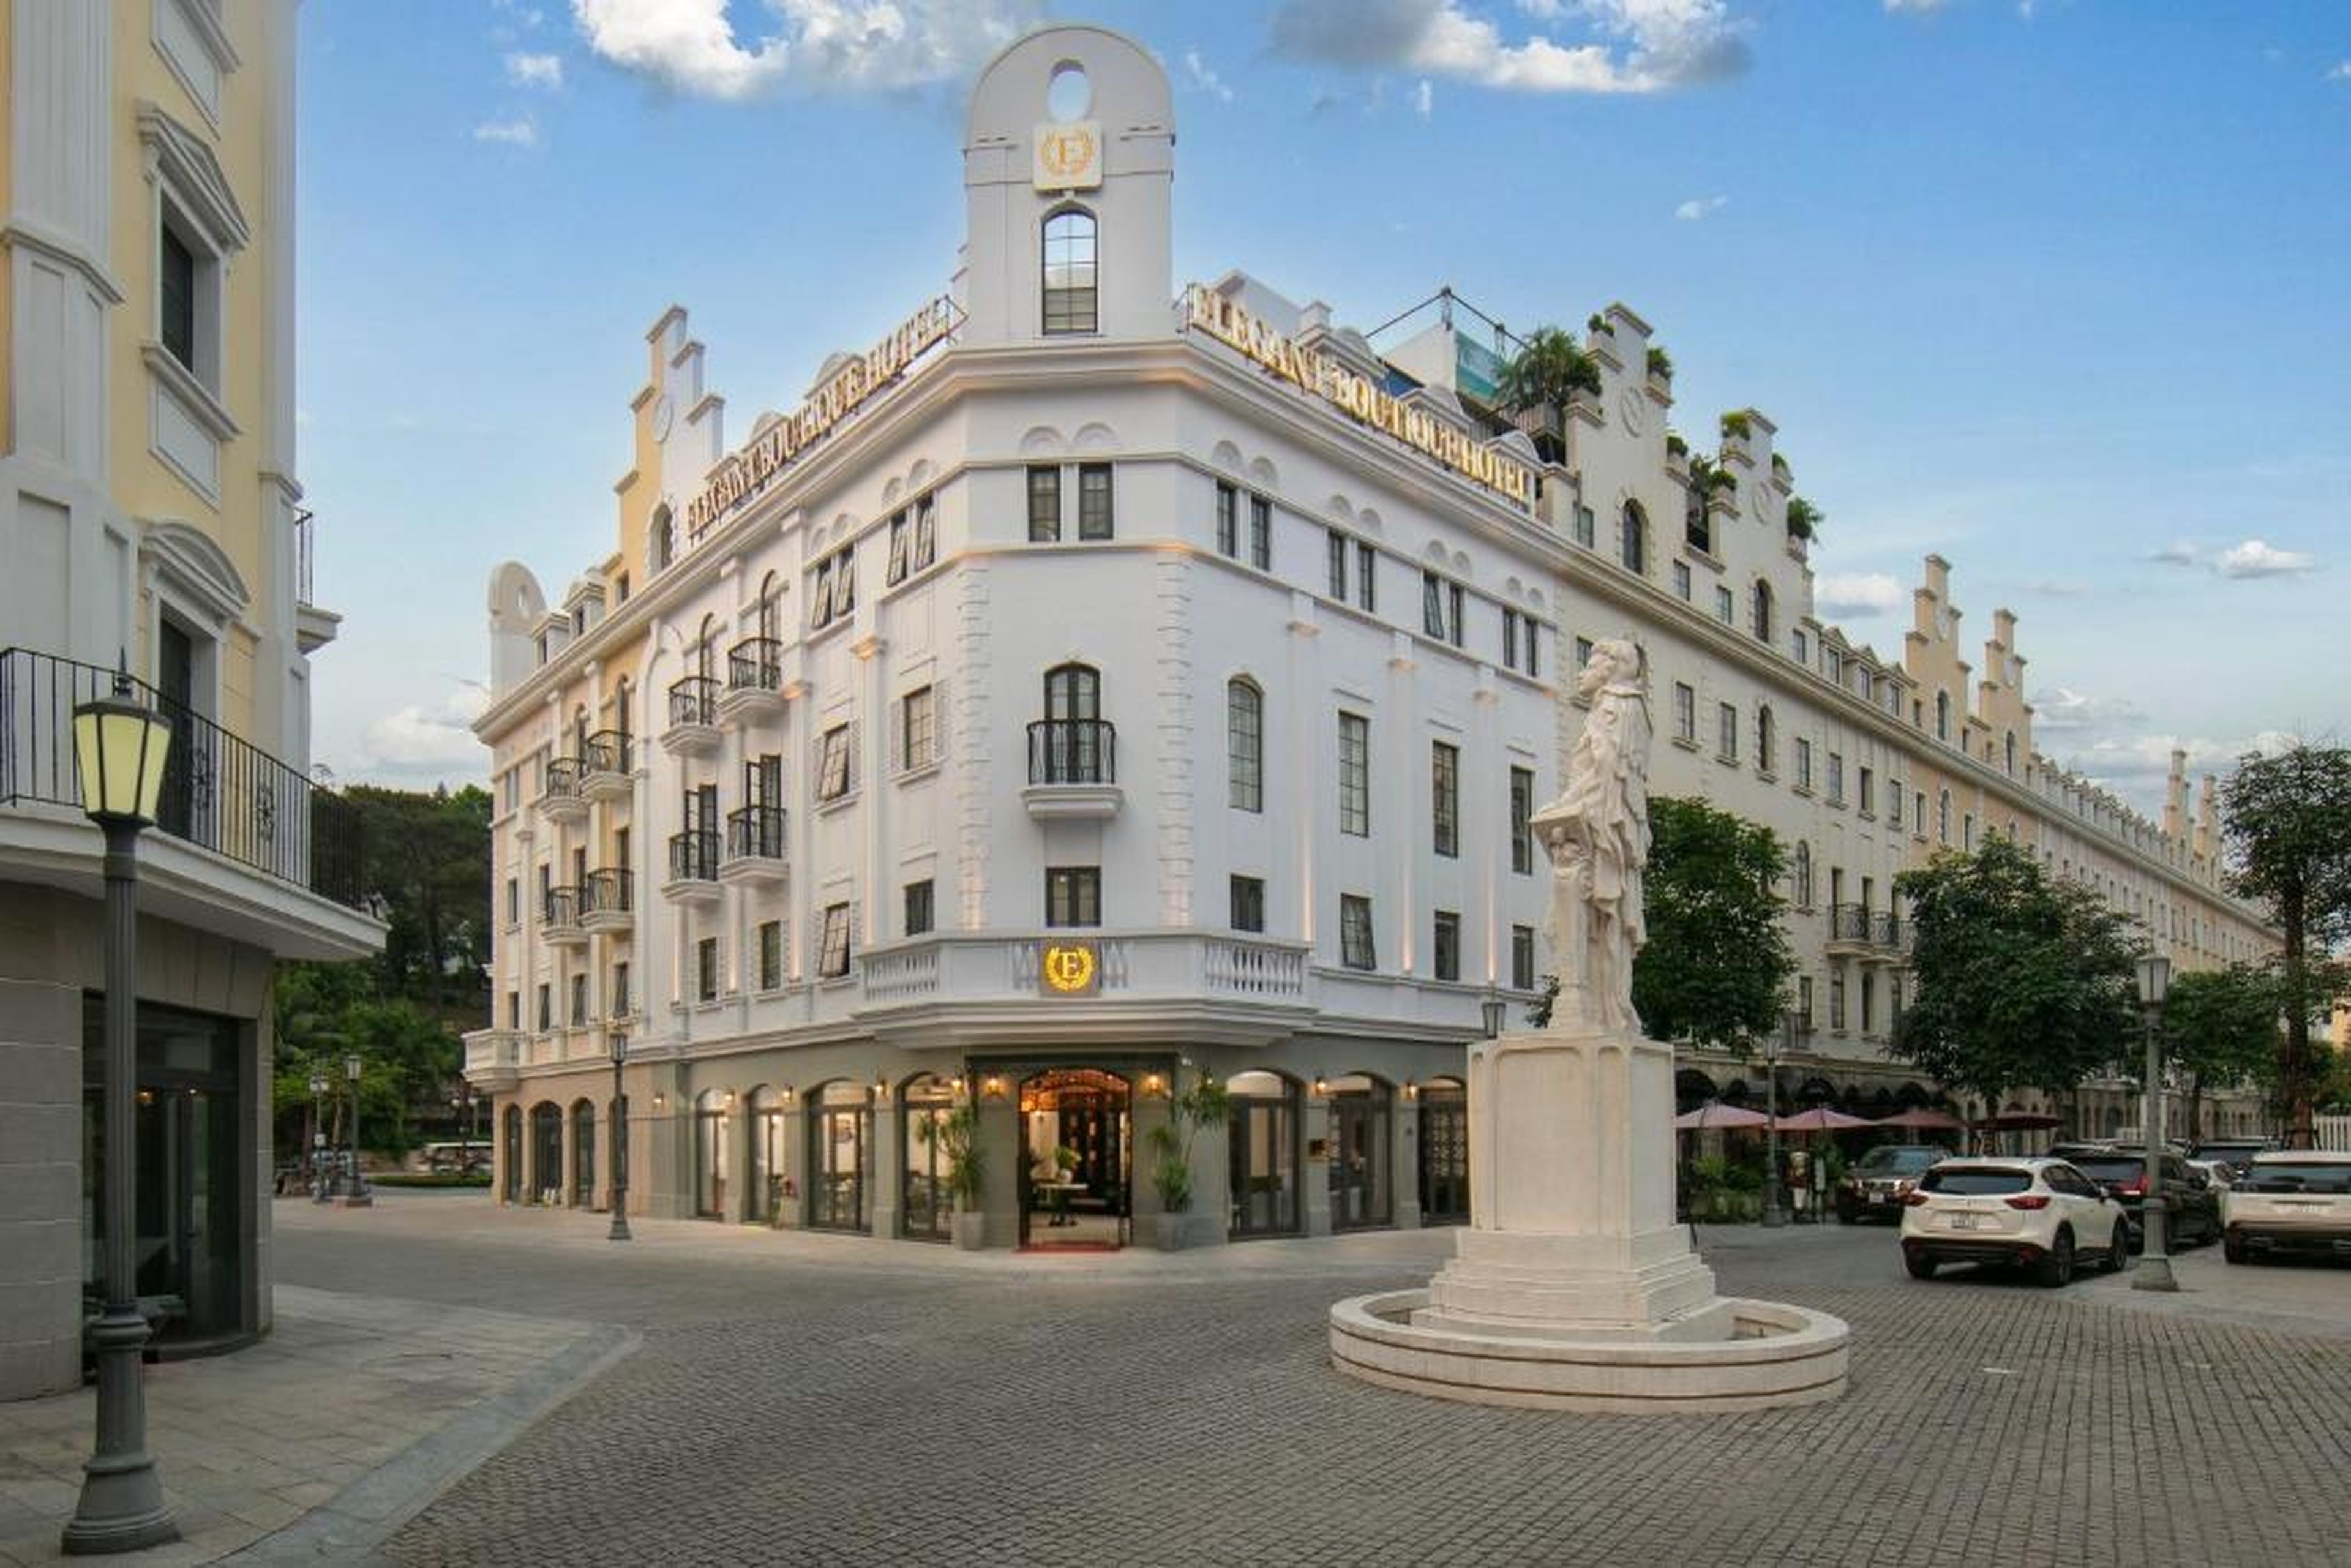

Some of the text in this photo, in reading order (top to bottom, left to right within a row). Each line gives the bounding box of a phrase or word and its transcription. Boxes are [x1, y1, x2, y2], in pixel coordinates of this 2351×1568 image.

[1191, 284, 1528, 499] ELEGANT BOUTIQUE HOTEL
[1061, 953, 1079, 978] E
